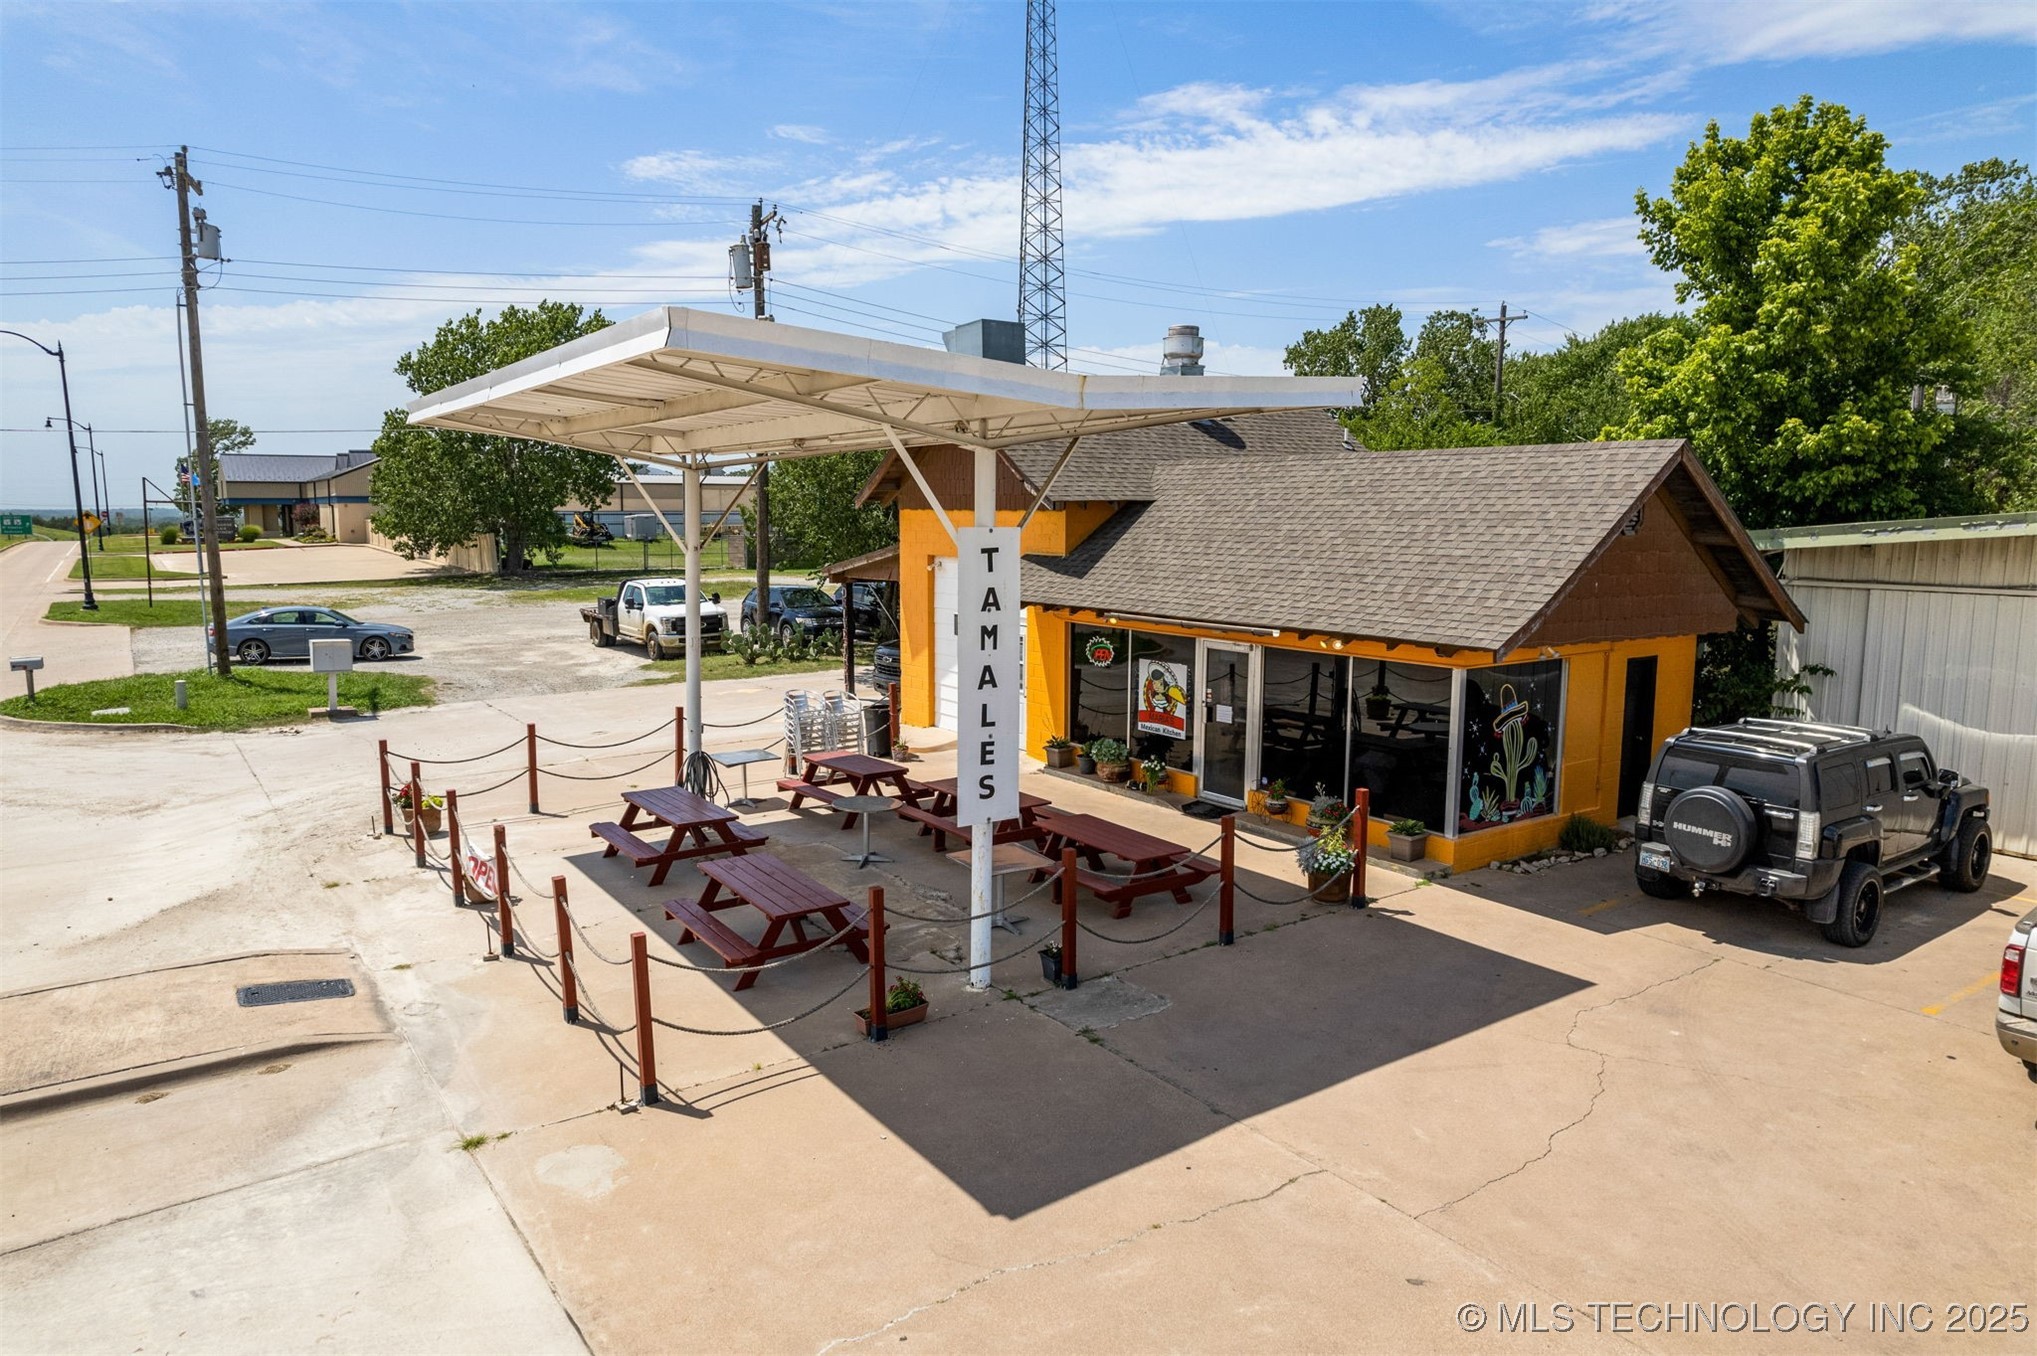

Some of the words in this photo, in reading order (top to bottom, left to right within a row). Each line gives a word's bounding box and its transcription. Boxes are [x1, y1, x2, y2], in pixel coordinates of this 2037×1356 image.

[977, 546, 1002, 799] TAMALES
[1140, 723, 1161, 733] Mexican
[1162, 727, 1182, 738] Kitchen
[1673, 821, 1733, 841] HUMMER
